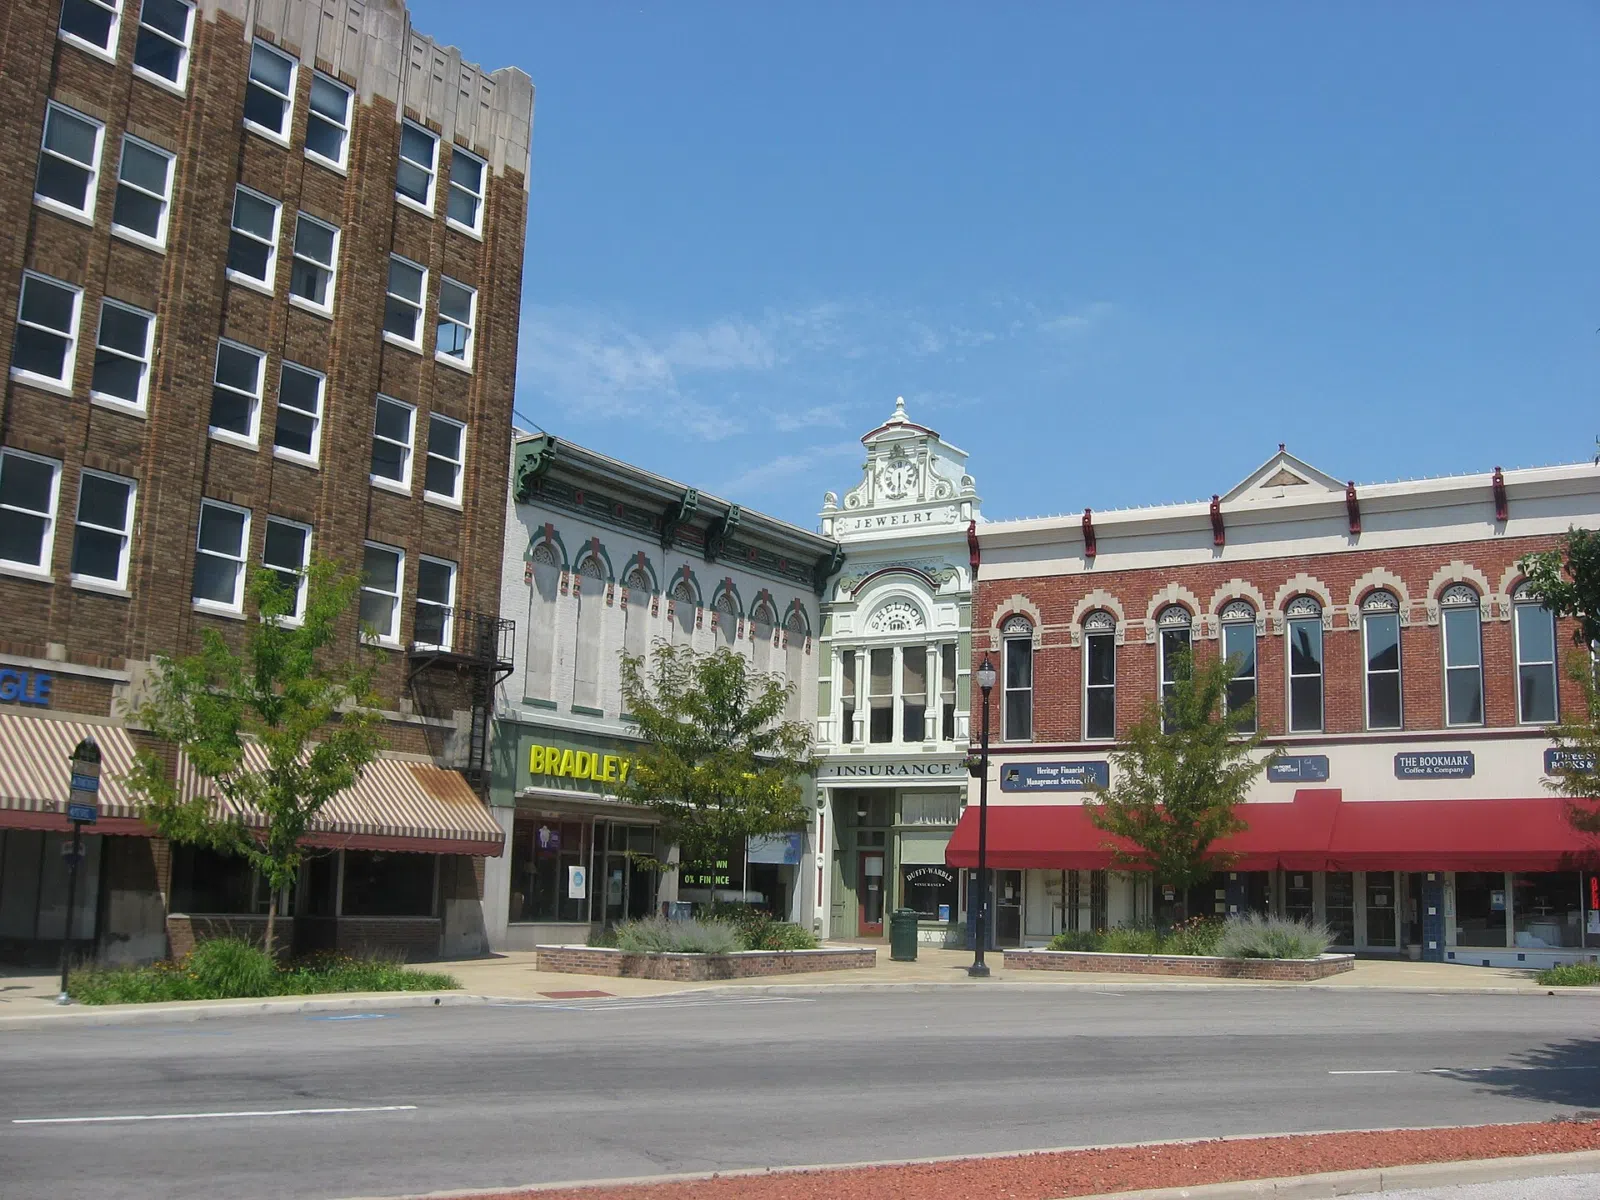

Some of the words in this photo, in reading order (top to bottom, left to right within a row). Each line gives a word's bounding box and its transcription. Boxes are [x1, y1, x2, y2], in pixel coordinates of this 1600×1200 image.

[855, 512, 932, 529] JEWELRY
[871, 602, 923, 630] SHELDON
[529, 744, 630, 784] BRADLEY
[1400, 757, 1417, 767] THE
[1420, 756, 1469, 767] BOOKMARK
[1586, 761, 1594, 769] &
[836, 763, 952, 777] INSURANCE
[1036, 766, 1060, 776] Heritage
[1060, 766, 1085, 774] Financial
[1404, 766, 1426, 774] Coffee
[1433, 766, 1465, 774] Company
[1026, 777, 1060, 787] Management
[684, 874, 695, 884] 0%
[699, 875, 730, 885] FINNCE
